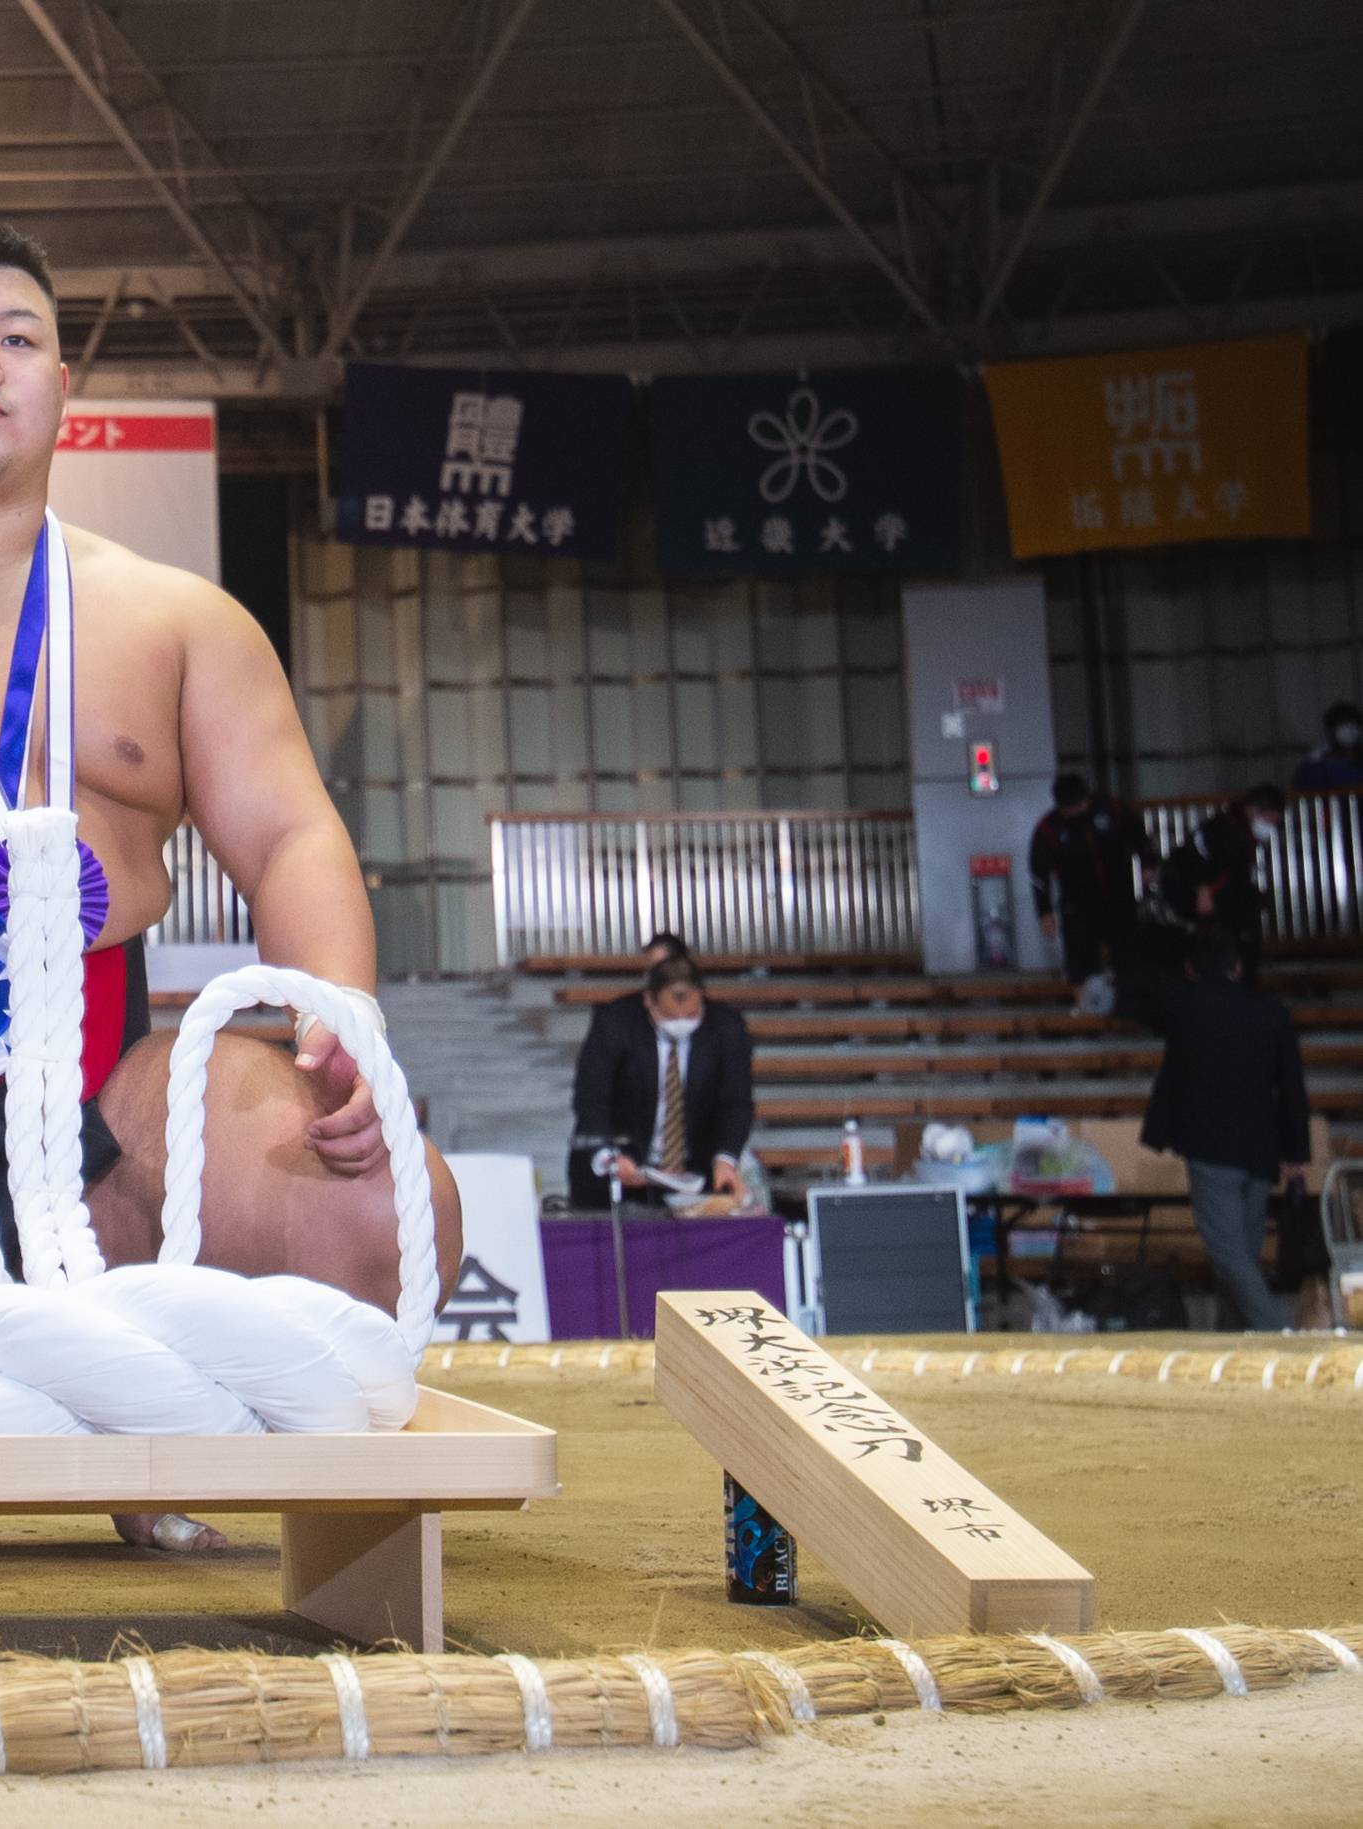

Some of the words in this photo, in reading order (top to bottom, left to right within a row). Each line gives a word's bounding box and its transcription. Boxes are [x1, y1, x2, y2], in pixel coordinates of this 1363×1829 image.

[364, 494, 576, 547] 日本体育大学
